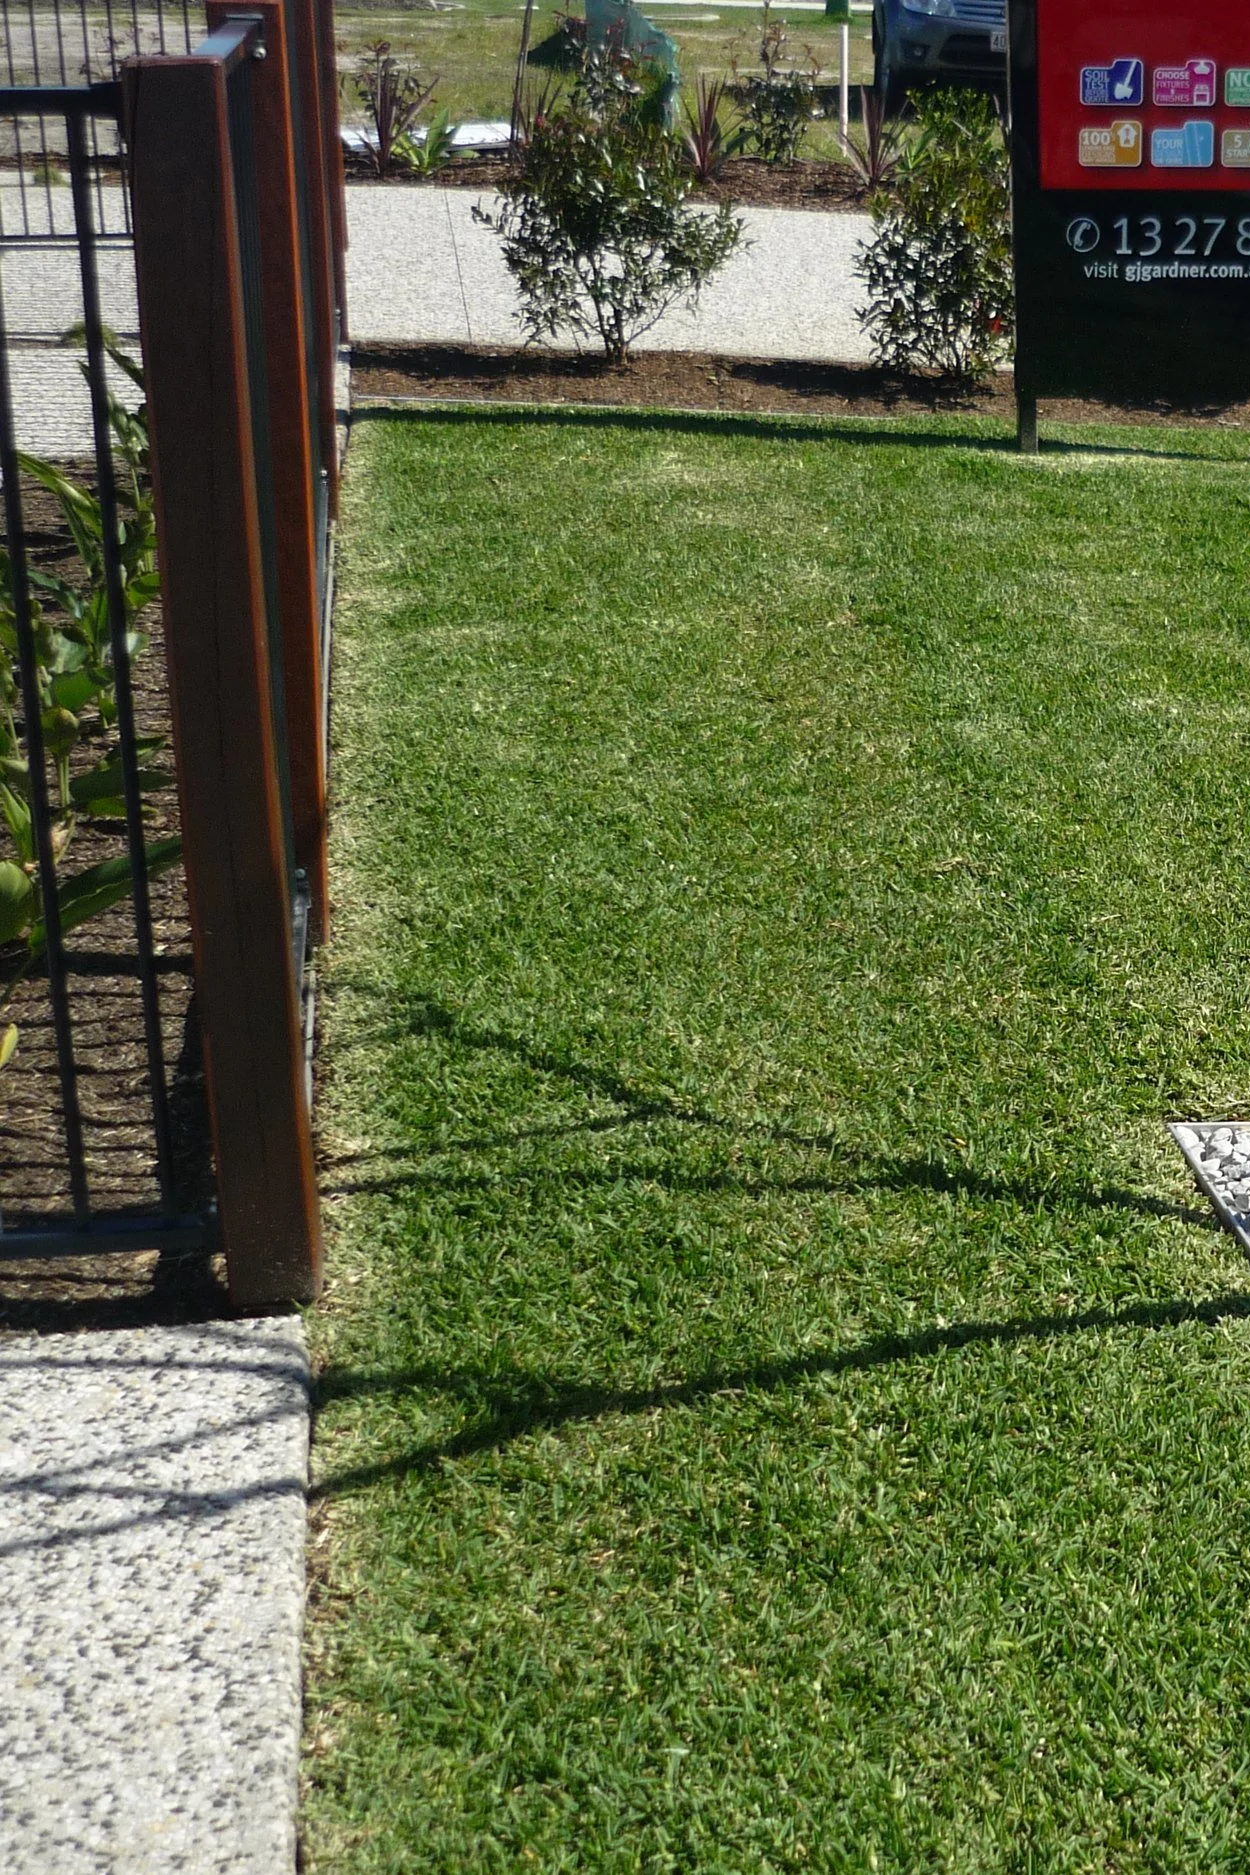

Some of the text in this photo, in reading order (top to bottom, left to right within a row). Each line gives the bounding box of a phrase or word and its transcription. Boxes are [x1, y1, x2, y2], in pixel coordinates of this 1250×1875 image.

[1085, 70, 1108, 80] SOIL
[1156, 71, 1190, 80] CHOOSE
[1085, 79, 1110, 89] TEST
[1155, 138, 1184, 149] YOUR
[1233, 134, 1242, 148] 5
[1225, 149, 1249, 158] STAR
[1113, 217, 1162, 256] 13
[1174, 218, 1226, 256] 27
[1083, 261, 1119, 279] visit
